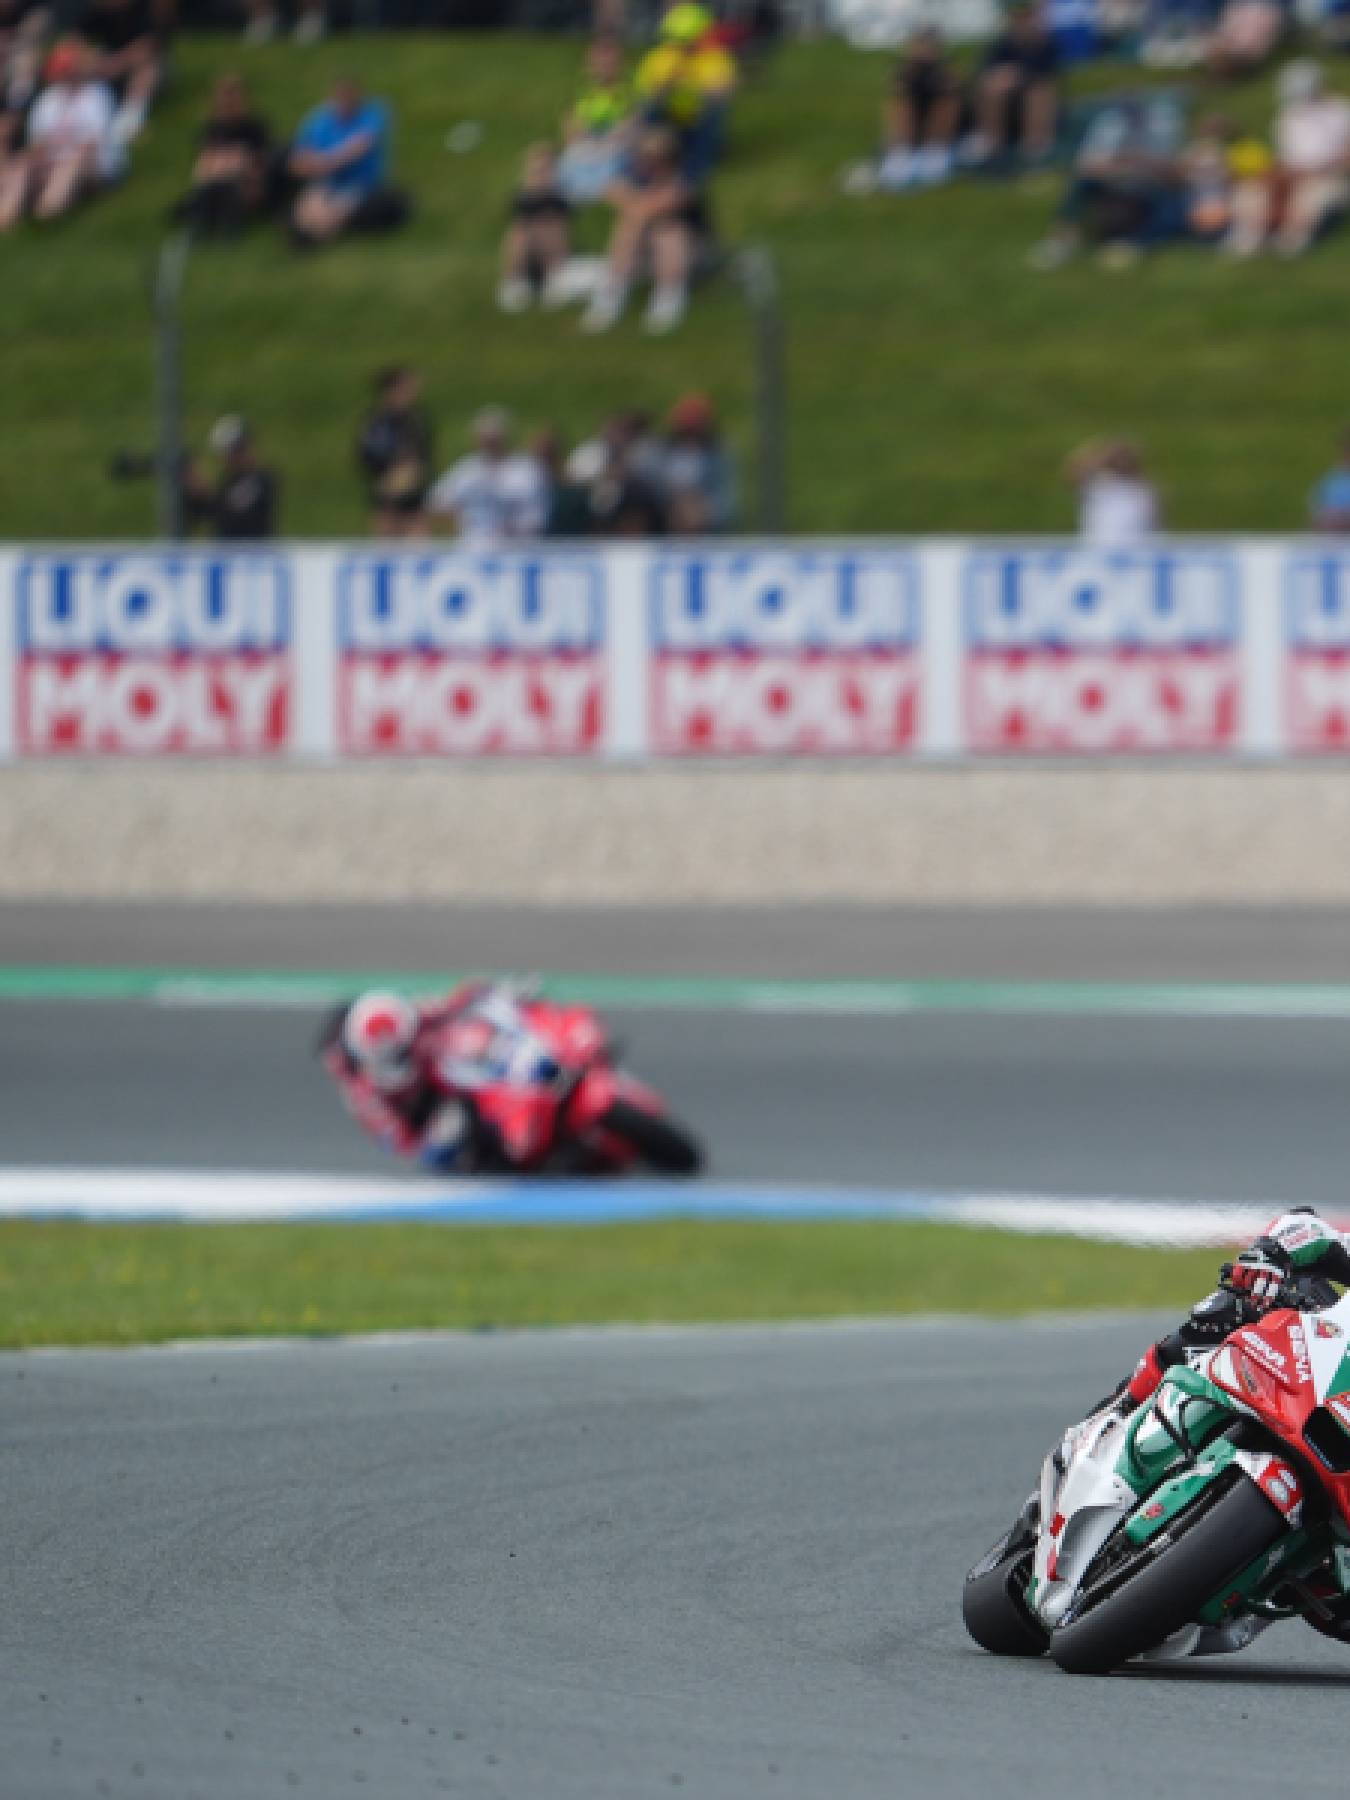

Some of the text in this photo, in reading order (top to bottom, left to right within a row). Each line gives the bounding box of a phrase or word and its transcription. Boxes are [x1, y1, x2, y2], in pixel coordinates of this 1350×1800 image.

[27, 558, 277, 646] LIQUI
[347, 558, 594, 646] LIQUI
[661, 556, 904, 644] LIQUI
[976, 554, 1224, 642] LIQUI
[29, 658, 286, 746] MOLY
[349, 658, 603, 746] MOLY
[663, 656, 913, 744] MOLY
[978, 654, 1233, 742] MOLY
